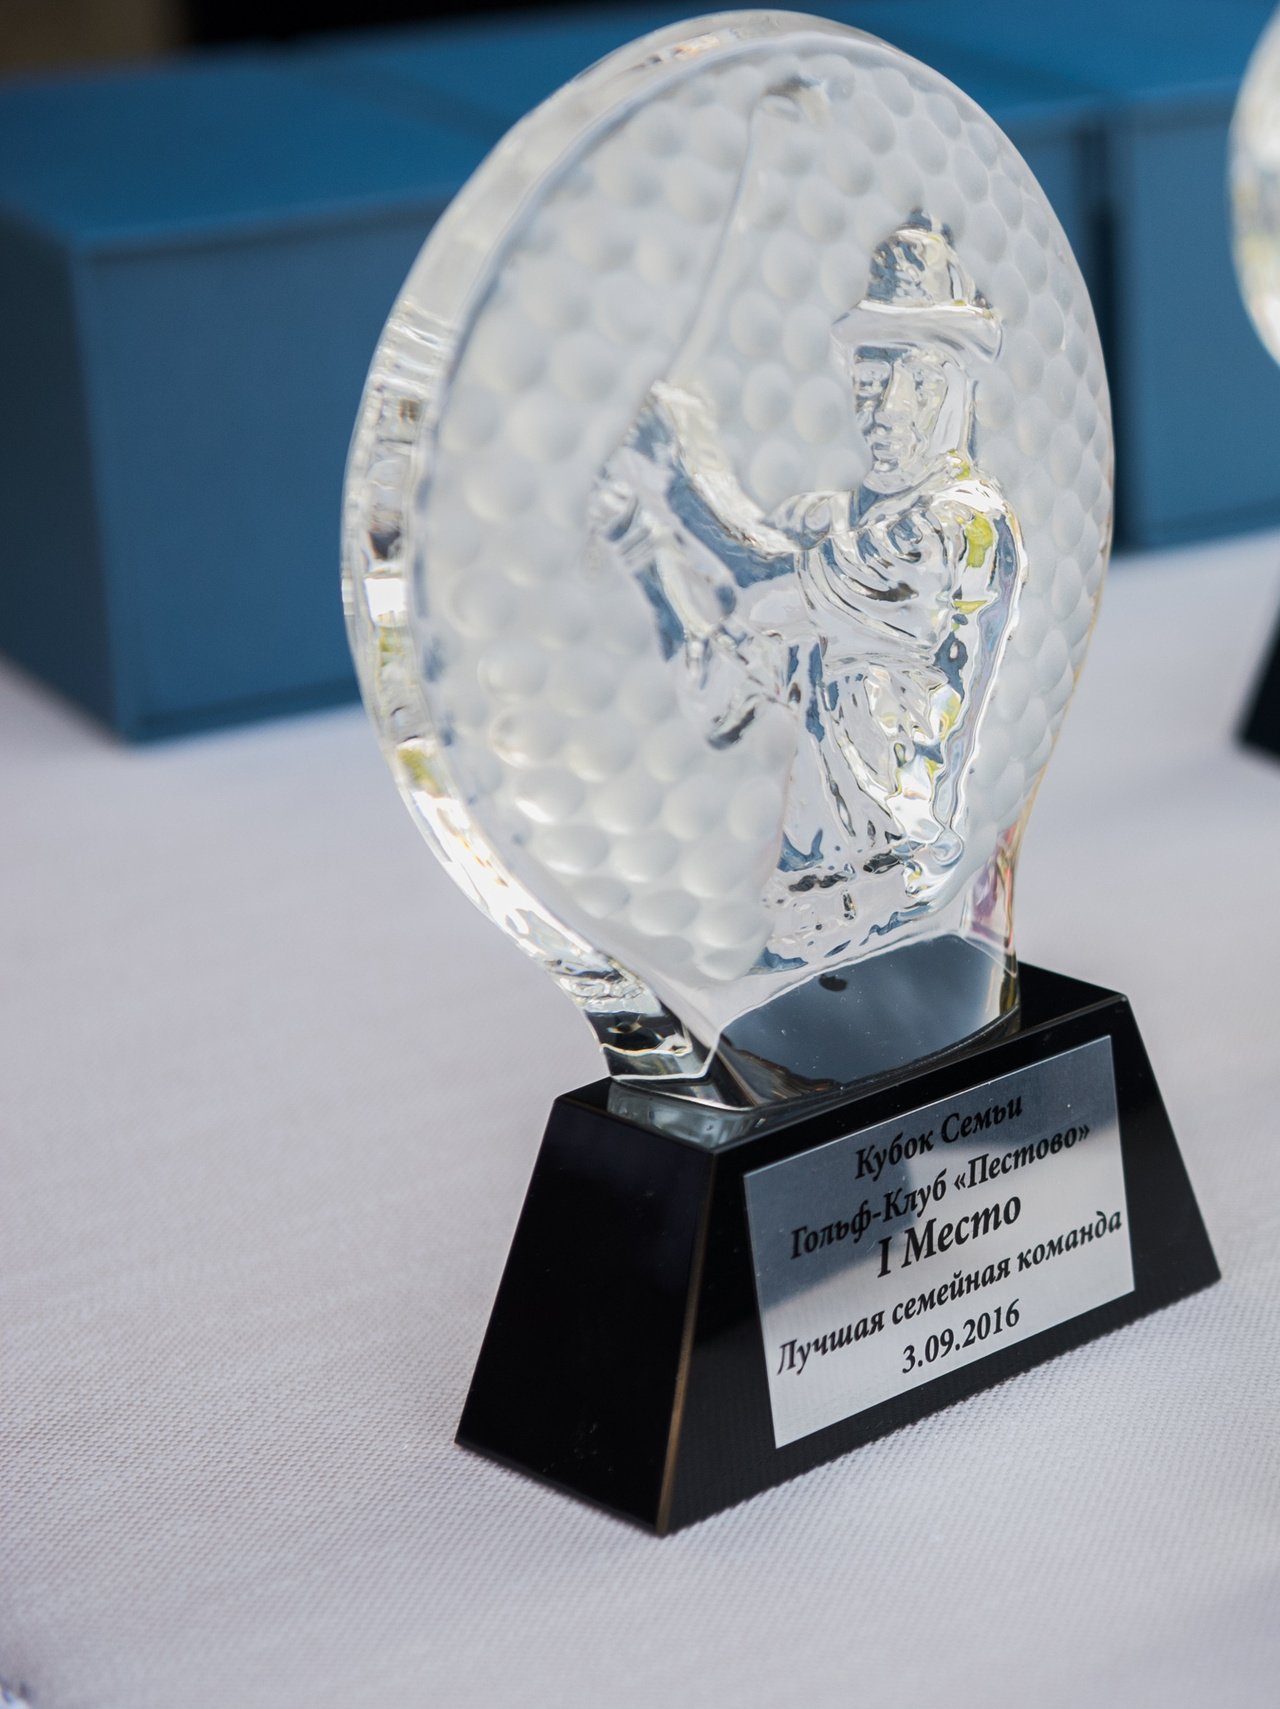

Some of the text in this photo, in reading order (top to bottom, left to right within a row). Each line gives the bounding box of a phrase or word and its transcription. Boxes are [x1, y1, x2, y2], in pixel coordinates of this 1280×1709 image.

[855, 1096, 1023, 1182] Кубок Семьи
[790, 1124, 1090, 1259] Гольф-Клуб «Пестово»
[901, 1196, 1022, 1268] Место
[776, 1210, 1122, 1376] Лучшая семейная команда
[901, 1299, 1020, 1374] 3.09.2016
